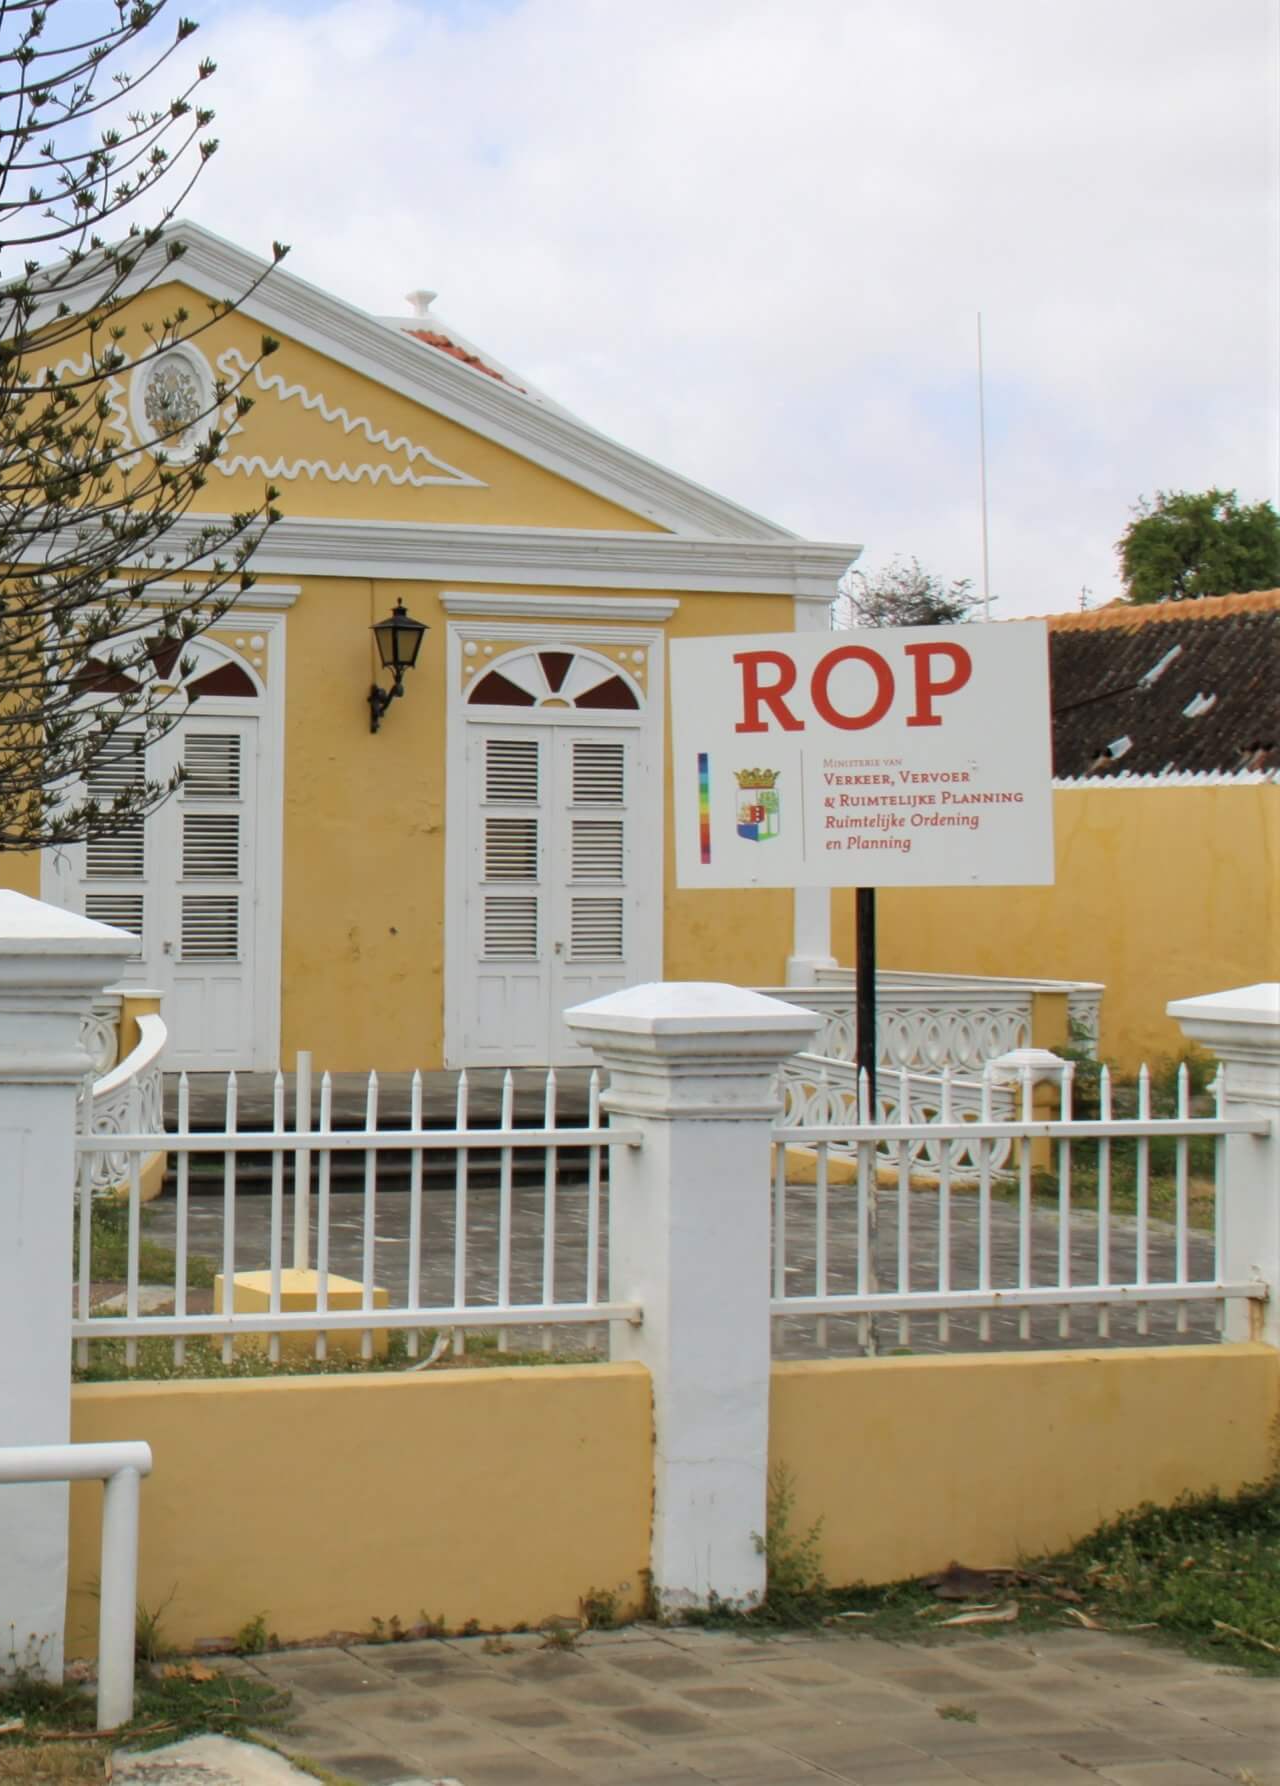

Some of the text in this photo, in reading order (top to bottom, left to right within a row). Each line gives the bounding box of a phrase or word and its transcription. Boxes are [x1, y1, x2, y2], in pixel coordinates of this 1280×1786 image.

[734, 641, 973, 733] ROP
[824, 796, 835, 808] &
[825, 812, 980, 832] Ruimtelijke Ordening
[826, 836, 912, 853] en Planning
